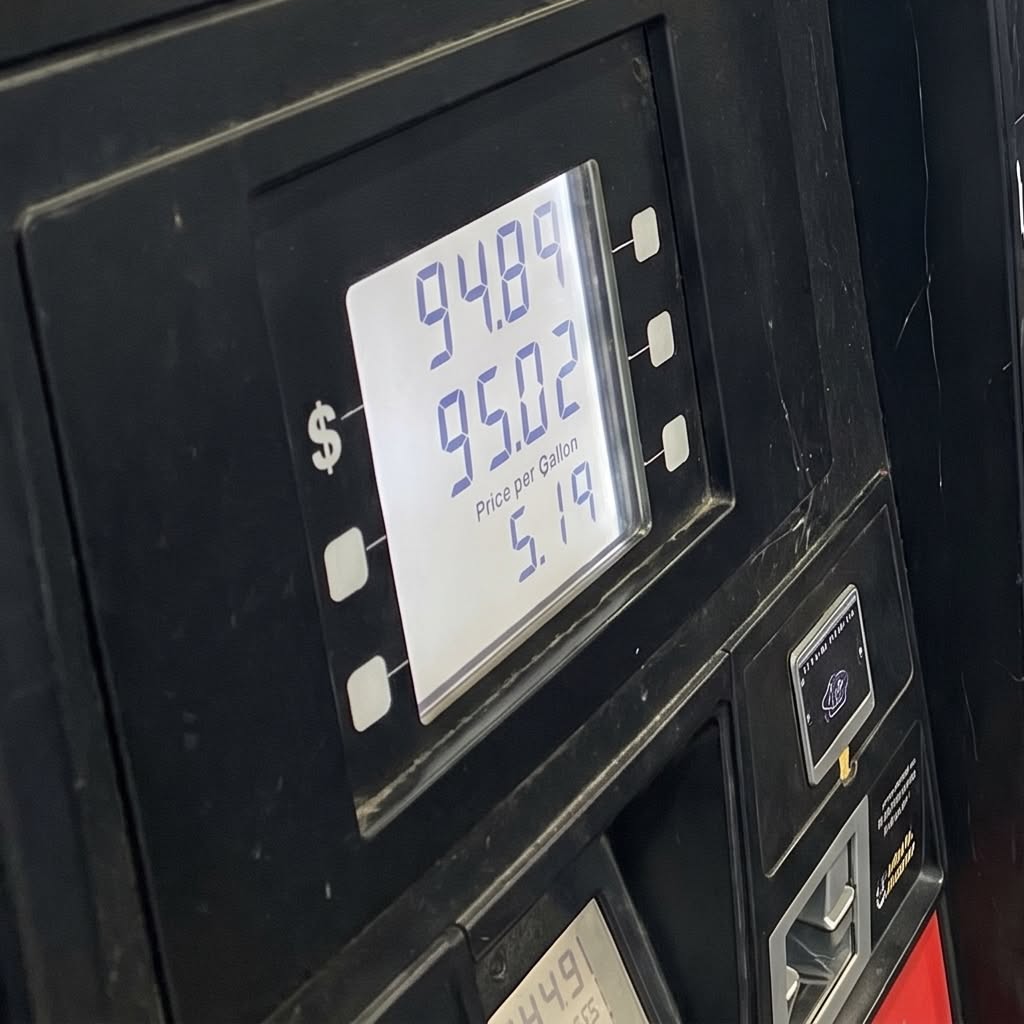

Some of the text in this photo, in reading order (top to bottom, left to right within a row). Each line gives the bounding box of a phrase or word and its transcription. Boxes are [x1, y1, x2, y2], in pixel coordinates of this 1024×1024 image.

[416, 199, 565, 370] 94.89
[307, 400, 342, 475] $
[437, 319, 581, 498] 95.02
[476, 437, 578, 522] Price per Gallon
